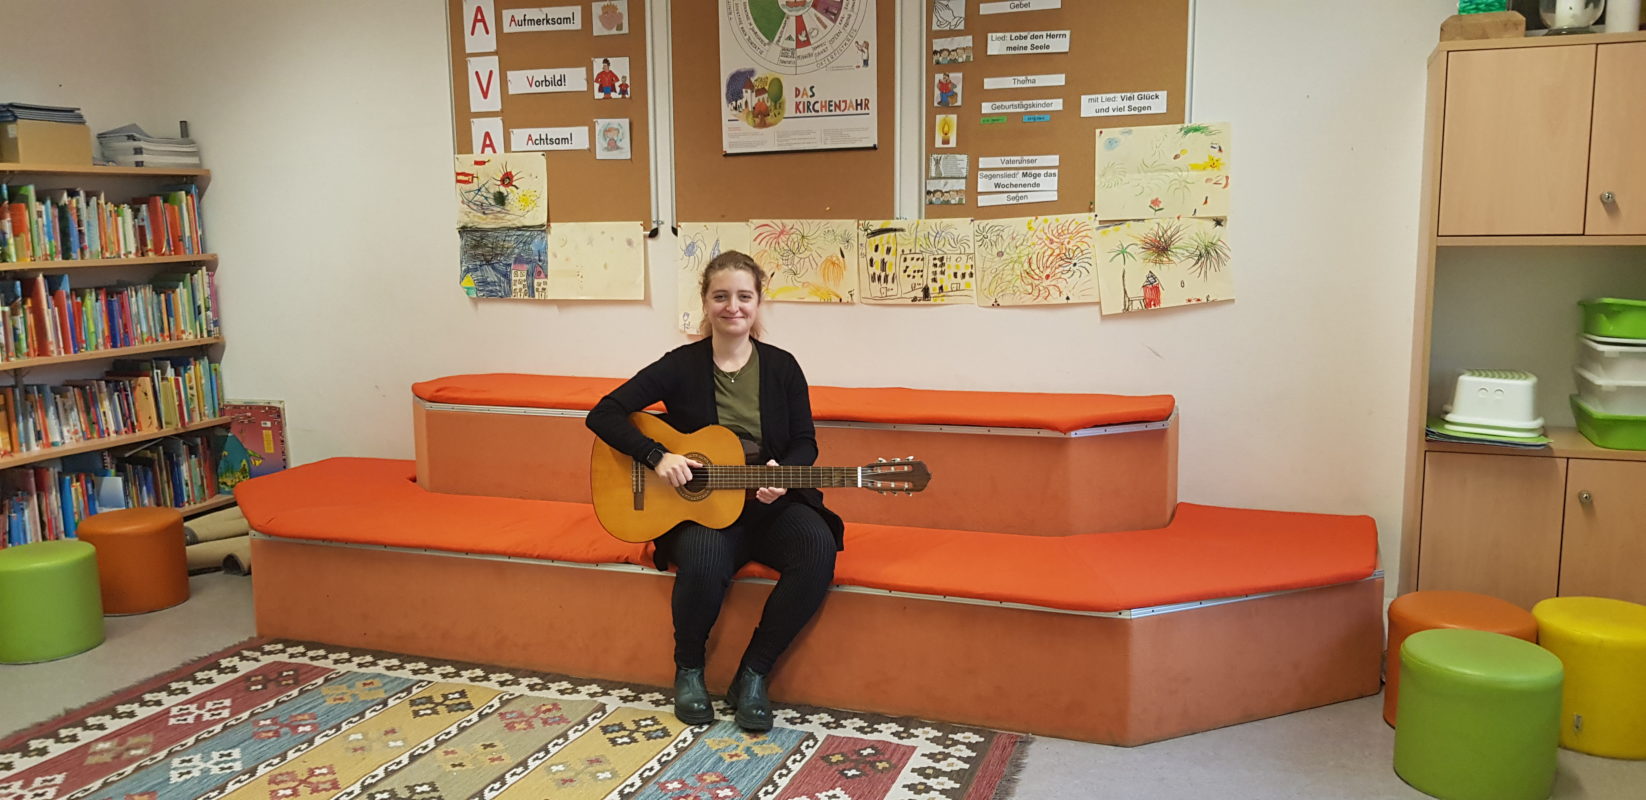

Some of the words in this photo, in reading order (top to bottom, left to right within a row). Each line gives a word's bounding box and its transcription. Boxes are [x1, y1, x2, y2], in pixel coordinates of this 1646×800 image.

[1009, 2, 1031, 10] Gebet
[470, 5, 490, 37] A
[509, 12, 575, 27] Aufmerksam!
[1009, 33, 1028, 41] Lobe
[1030, 32, 1044, 40] den
[1045, 32, 1067, 40] Herrn
[1006, 44, 1028, 52] meine
[1030, 43, 1050, 51] Seele
[475, 70, 494, 99] V
[526, 74, 567, 89] Vorbild!
[794, 85, 815, 98] DAS
[1120, 94, 1135, 102] Viel
[1137, 93, 1160, 101] Glück
[794, 98, 870, 114] KIRCHENJAHR
[991, 101, 1054, 111] Geburtstagskinder
[1095, 106, 1110, 114] und
[1111, 105, 1126, 113] viel
[1127, 104, 1152, 113] Segen
[526, 132, 573, 146] Achtsam!
[1000, 157, 1038, 165] Vaterunser
[979, 172, 1018, 180] Segenslied:
[1021, 171, 1042, 179] Möge
[1006, 194, 1028, 202] Segen
